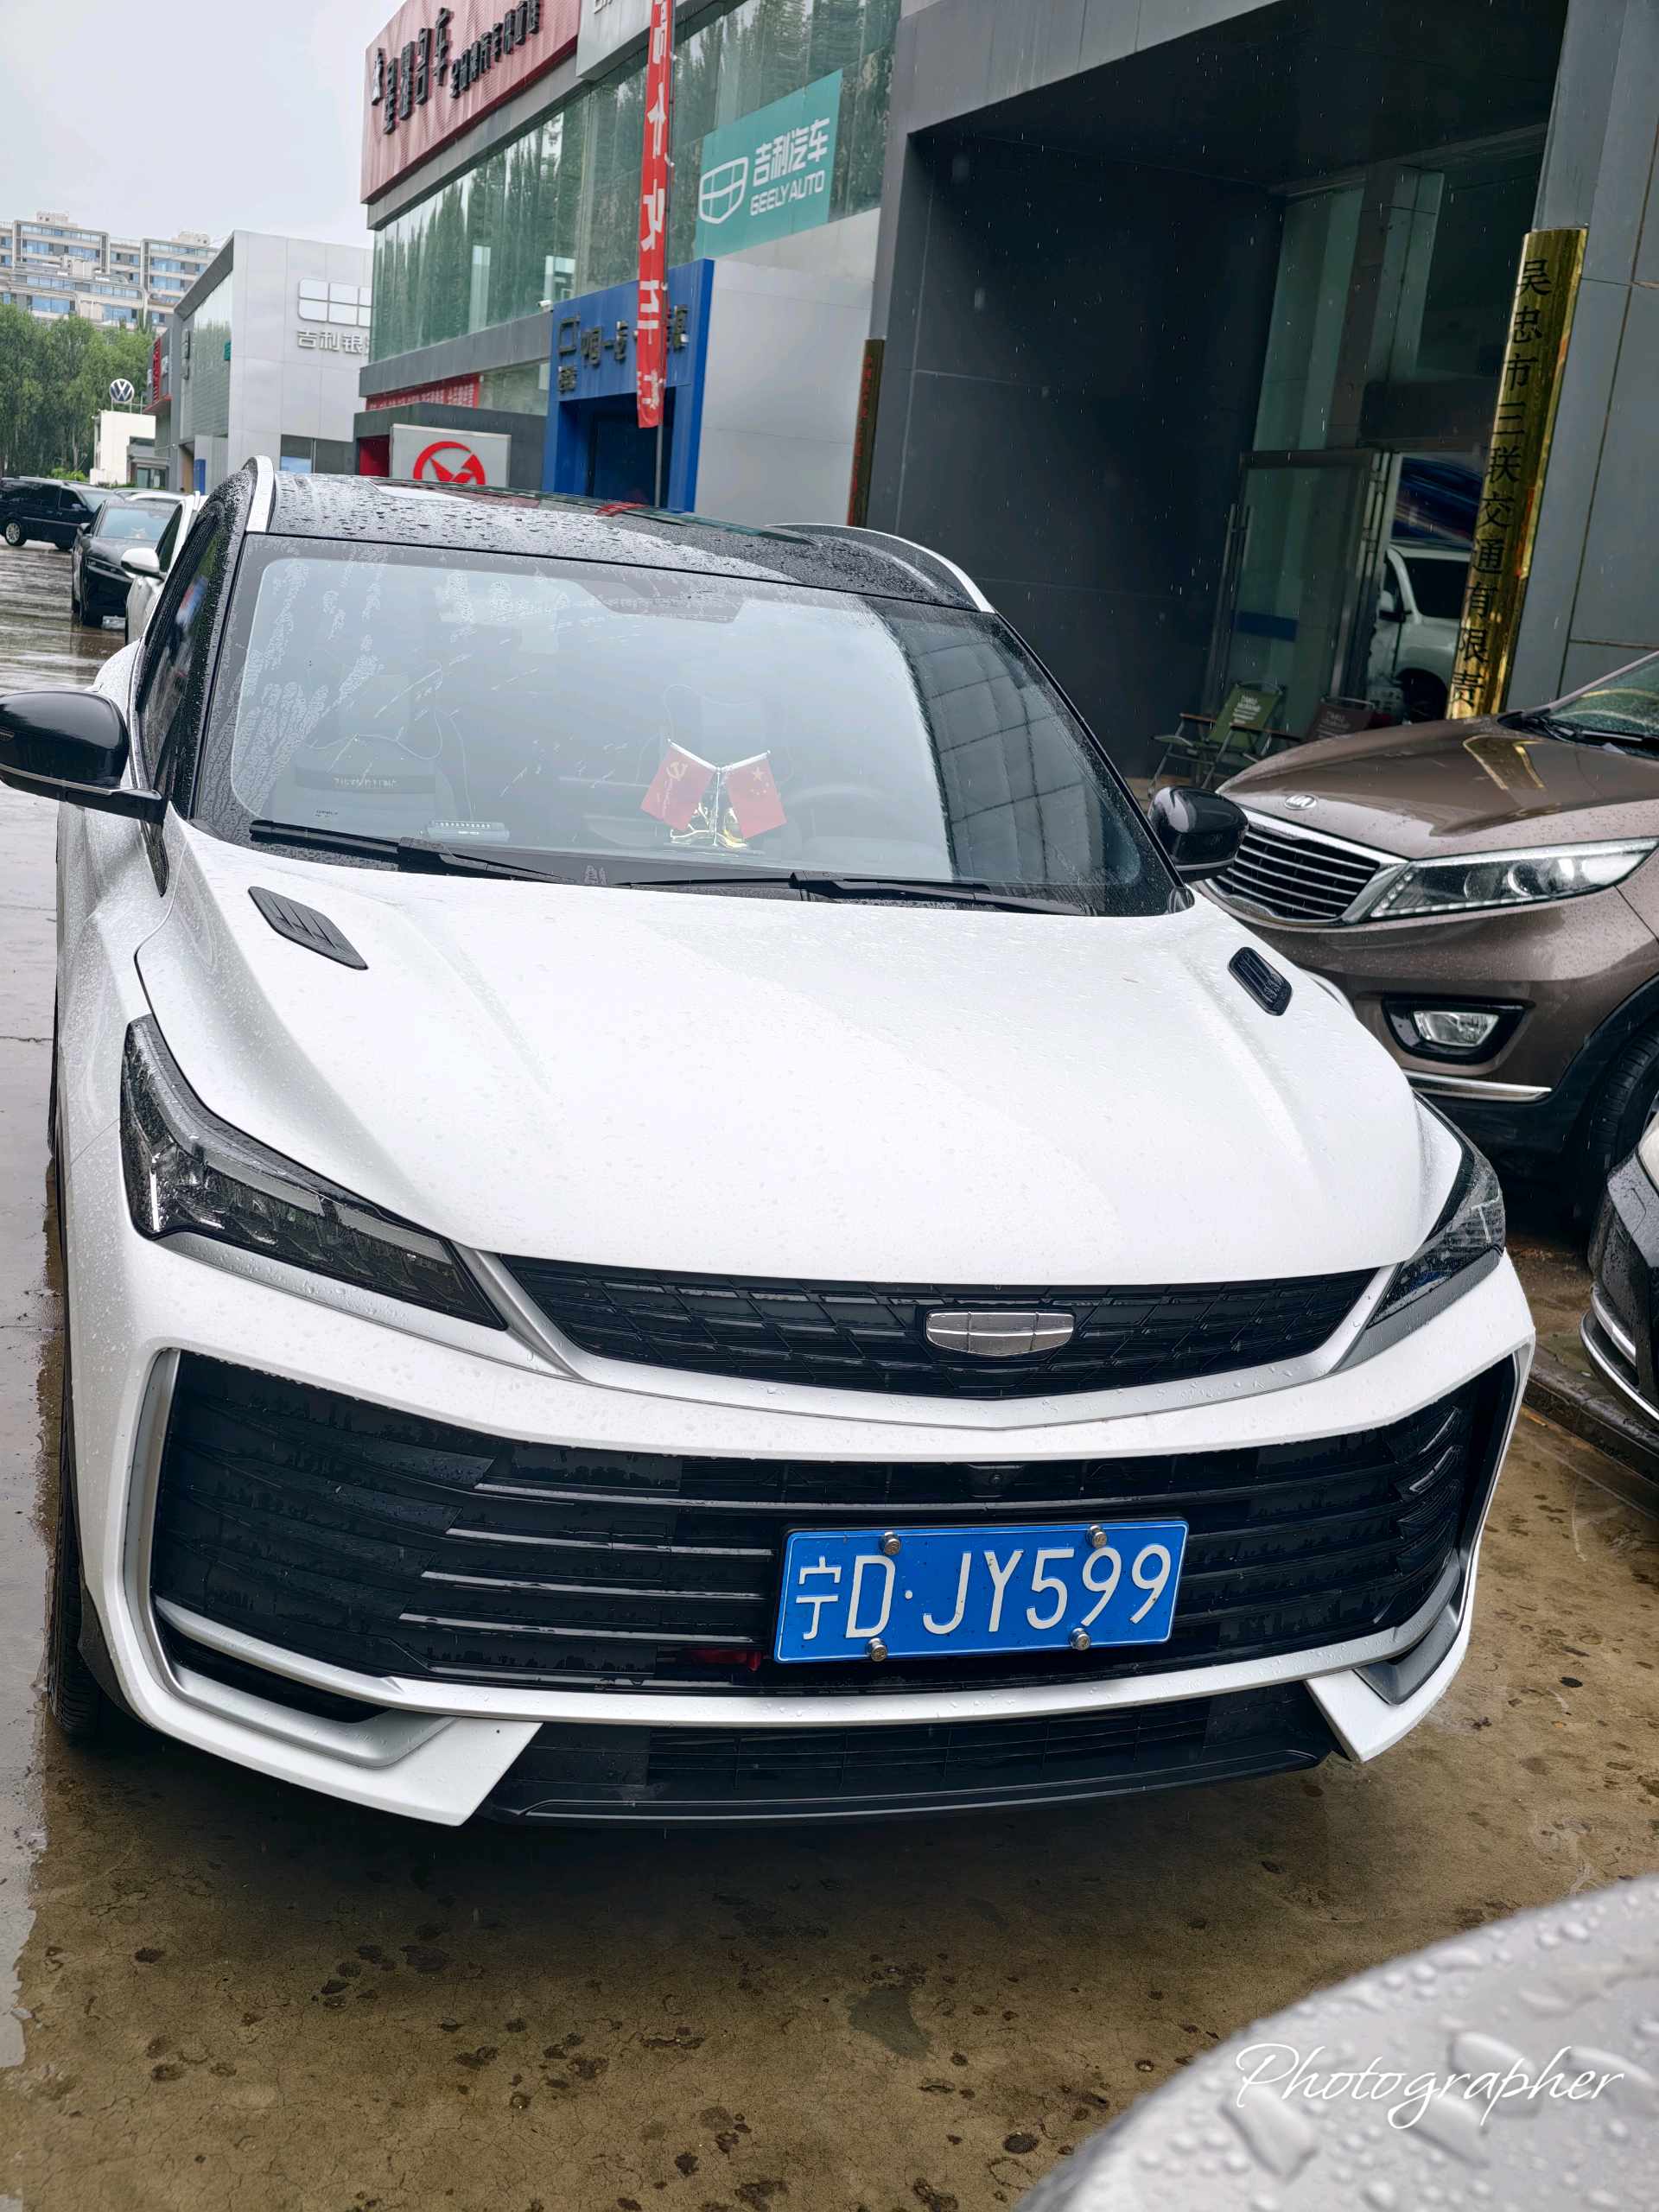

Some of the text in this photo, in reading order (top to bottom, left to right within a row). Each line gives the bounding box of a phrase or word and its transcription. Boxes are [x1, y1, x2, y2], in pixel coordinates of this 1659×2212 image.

[753, 118, 830, 188] 吉利汽车
[750, 169, 825, 216] GEELY AUTO
[297, 330, 370, 355] 吉利银
[1449, 259, 1552, 707] 吴忠市三联交通有限责
